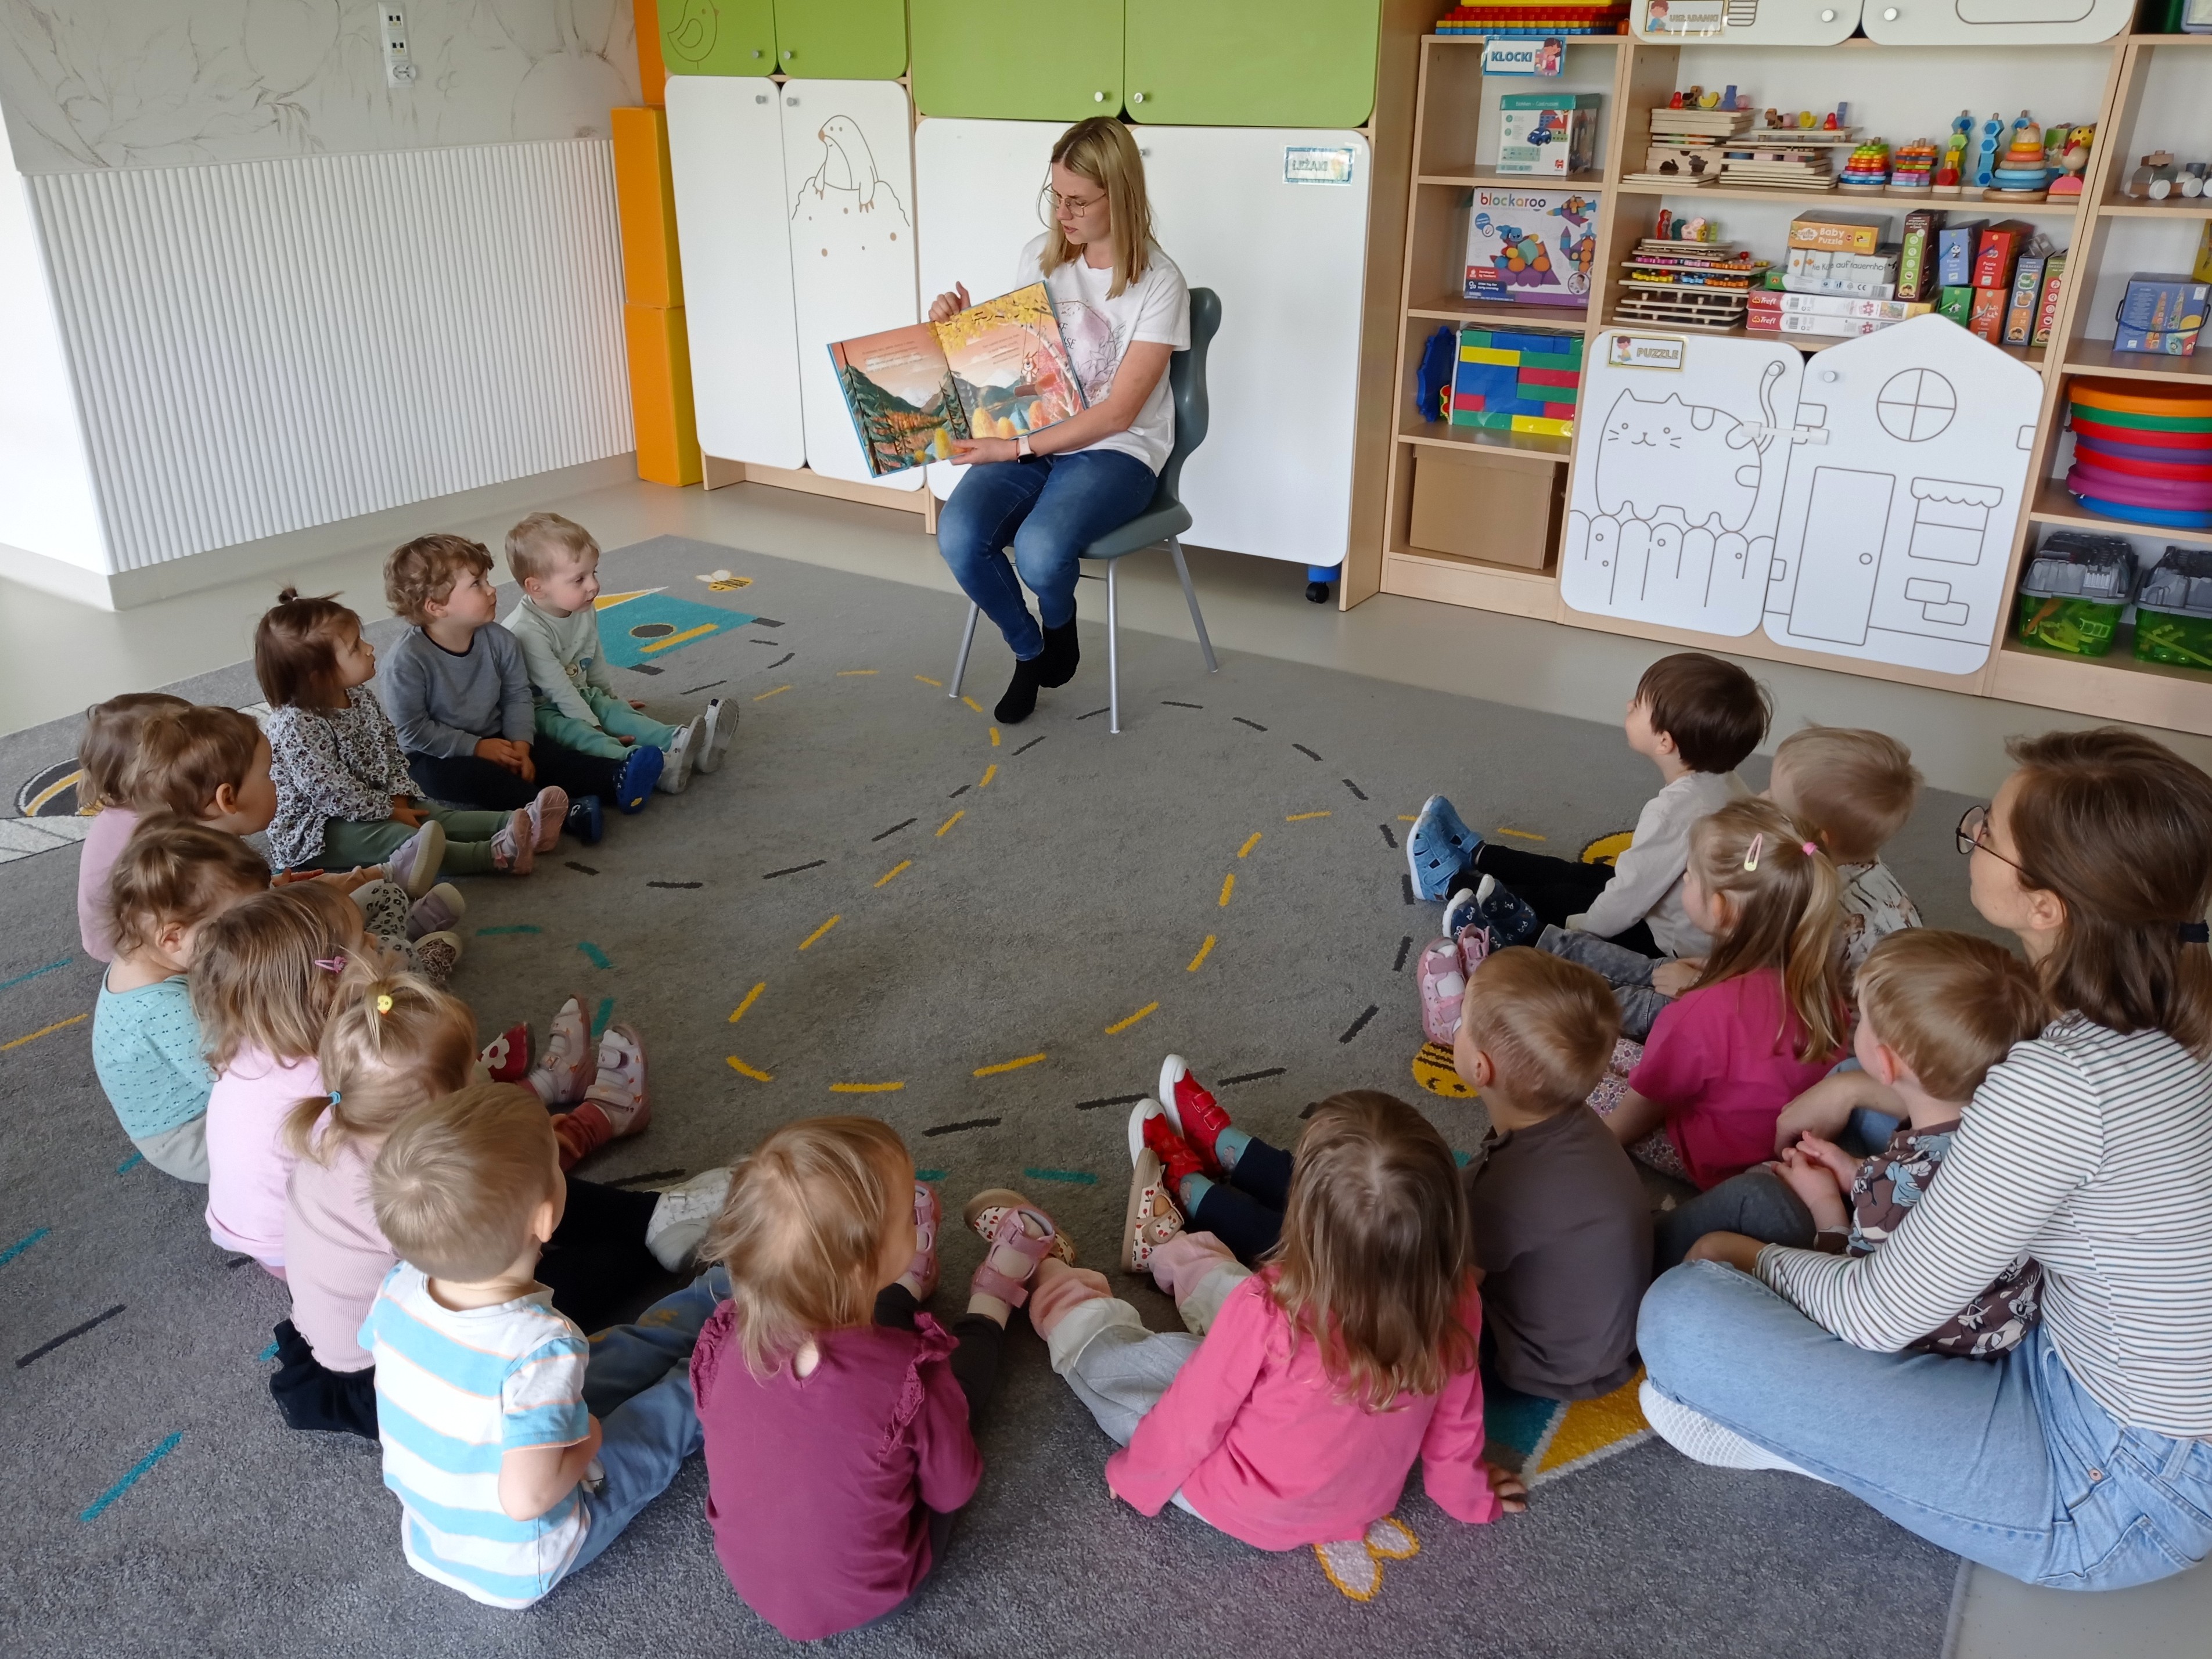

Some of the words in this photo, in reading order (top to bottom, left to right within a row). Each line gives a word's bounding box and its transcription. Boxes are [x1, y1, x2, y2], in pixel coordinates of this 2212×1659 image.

[1491, 51, 1533, 62] KLOCKI
[1292, 159, 1328, 171] LEŻAKI
[1480, 192, 1546, 208] blockaroo
[1819, 227, 1845, 239] Baby
[1818, 236, 1843, 245] Puzzle
[1760, 297, 1777, 306] Trefl
[1760, 316, 1776, 325] Trefl
[1636, 347, 1679, 360] PUZZLE
